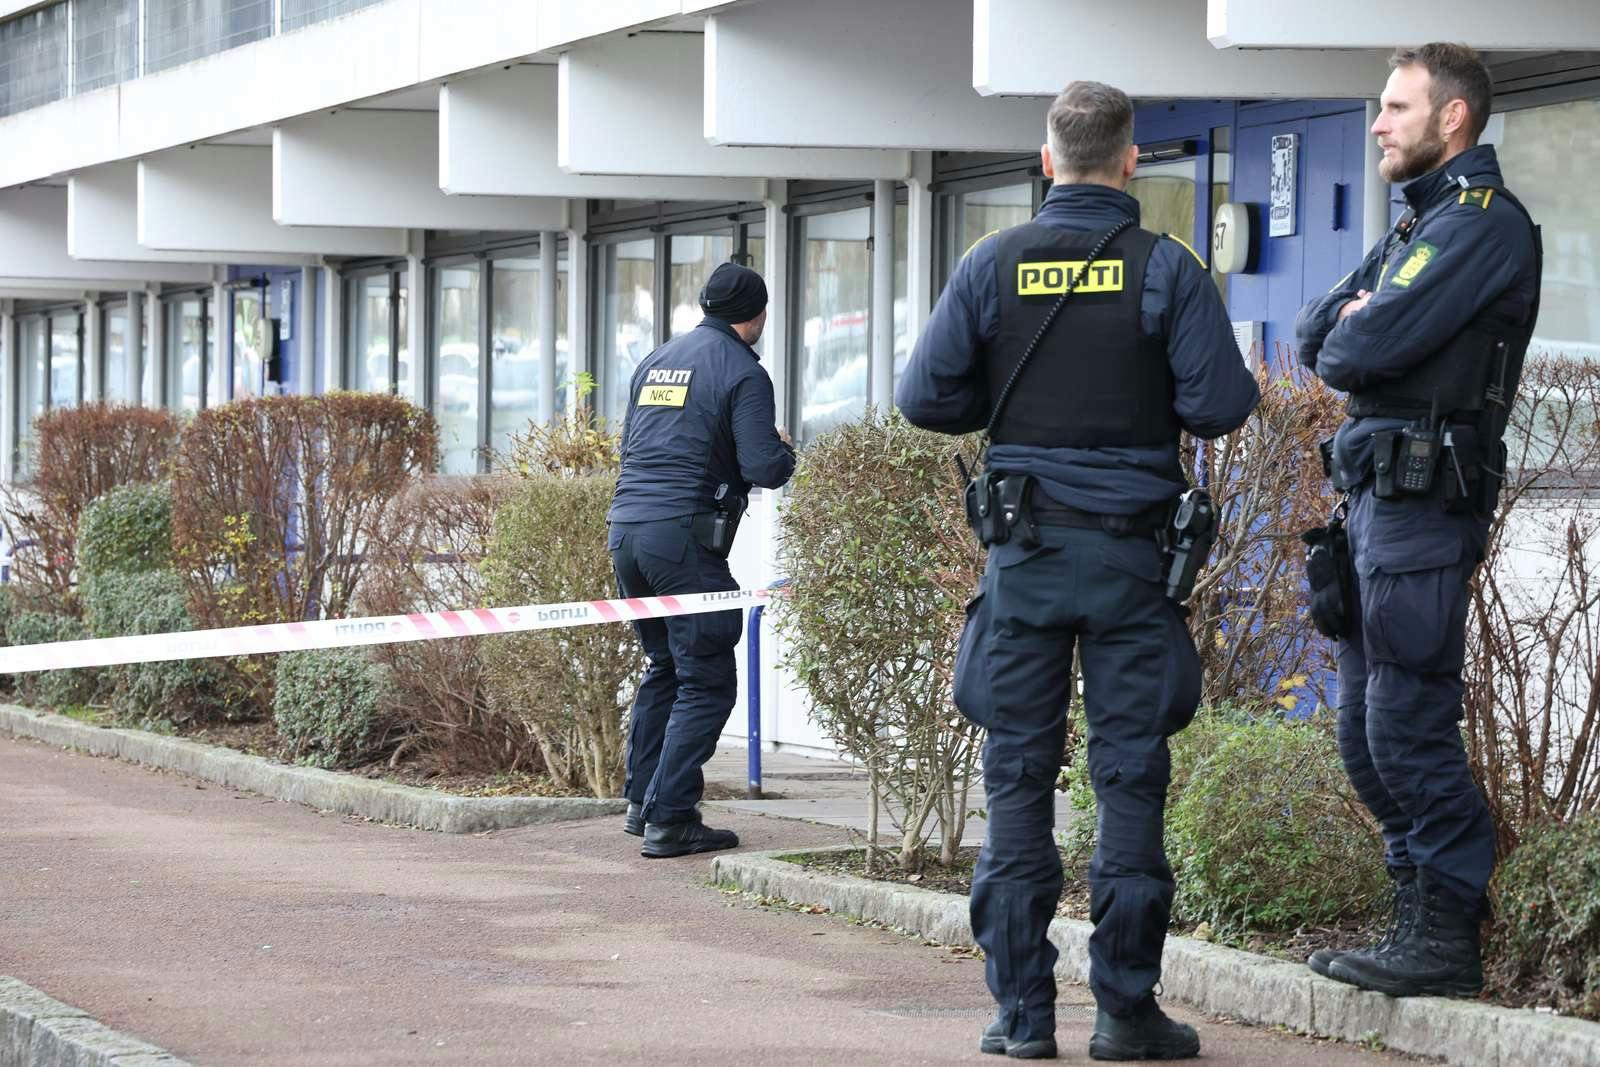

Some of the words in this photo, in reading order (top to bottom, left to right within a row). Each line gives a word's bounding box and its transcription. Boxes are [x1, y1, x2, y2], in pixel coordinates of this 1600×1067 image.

[1215, 222, 1226, 250] 57
[646, 369, 691, 383] POLITI
[650, 390, 673, 401] NKC
